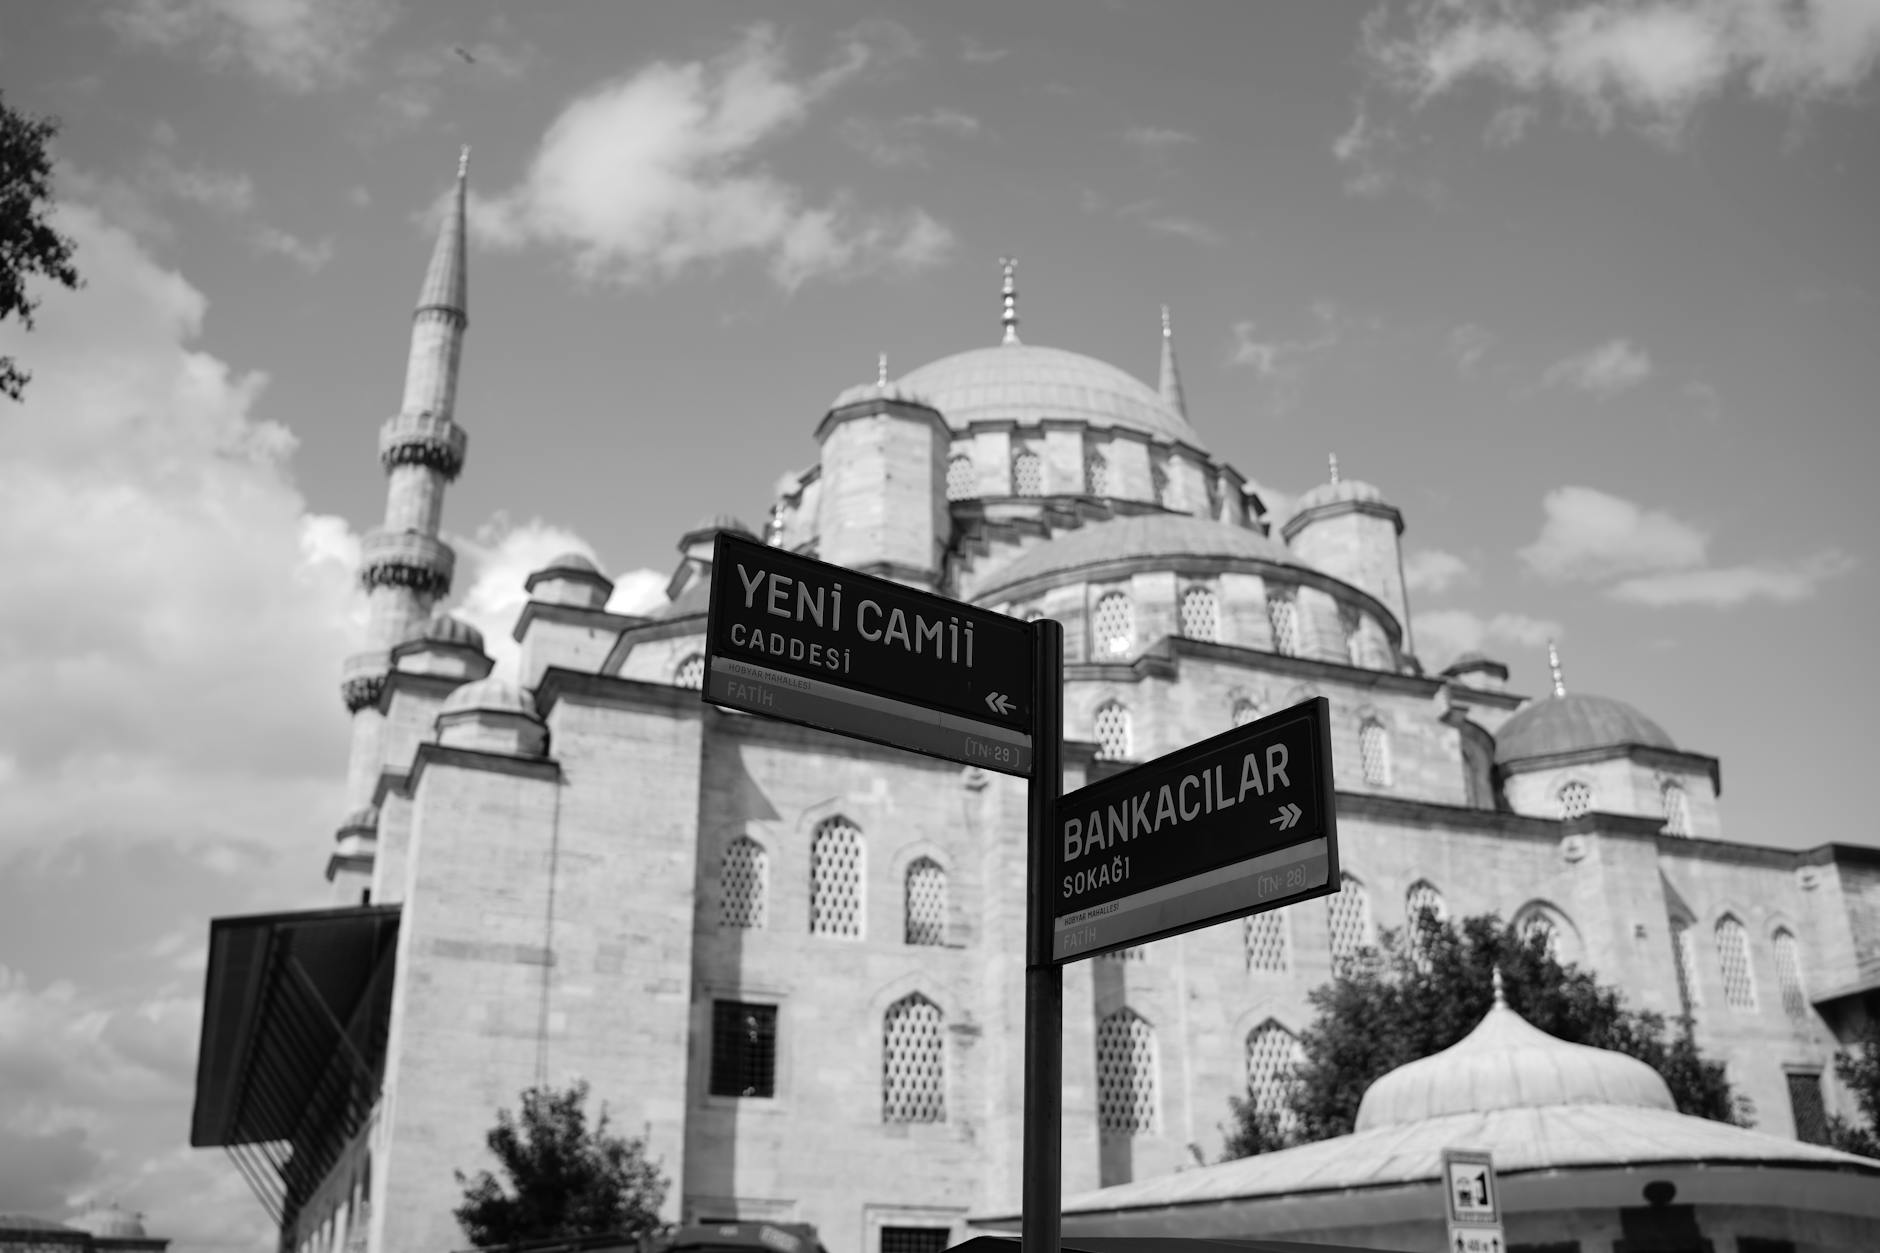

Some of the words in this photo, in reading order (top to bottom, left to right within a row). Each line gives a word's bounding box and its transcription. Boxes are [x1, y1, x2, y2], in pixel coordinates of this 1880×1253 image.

[728, 663, 763, 678] HOBYAR
[1064, 743, 1291, 863] BANKACILAR
[1063, 855, 1130, 898] SOKAĞI
